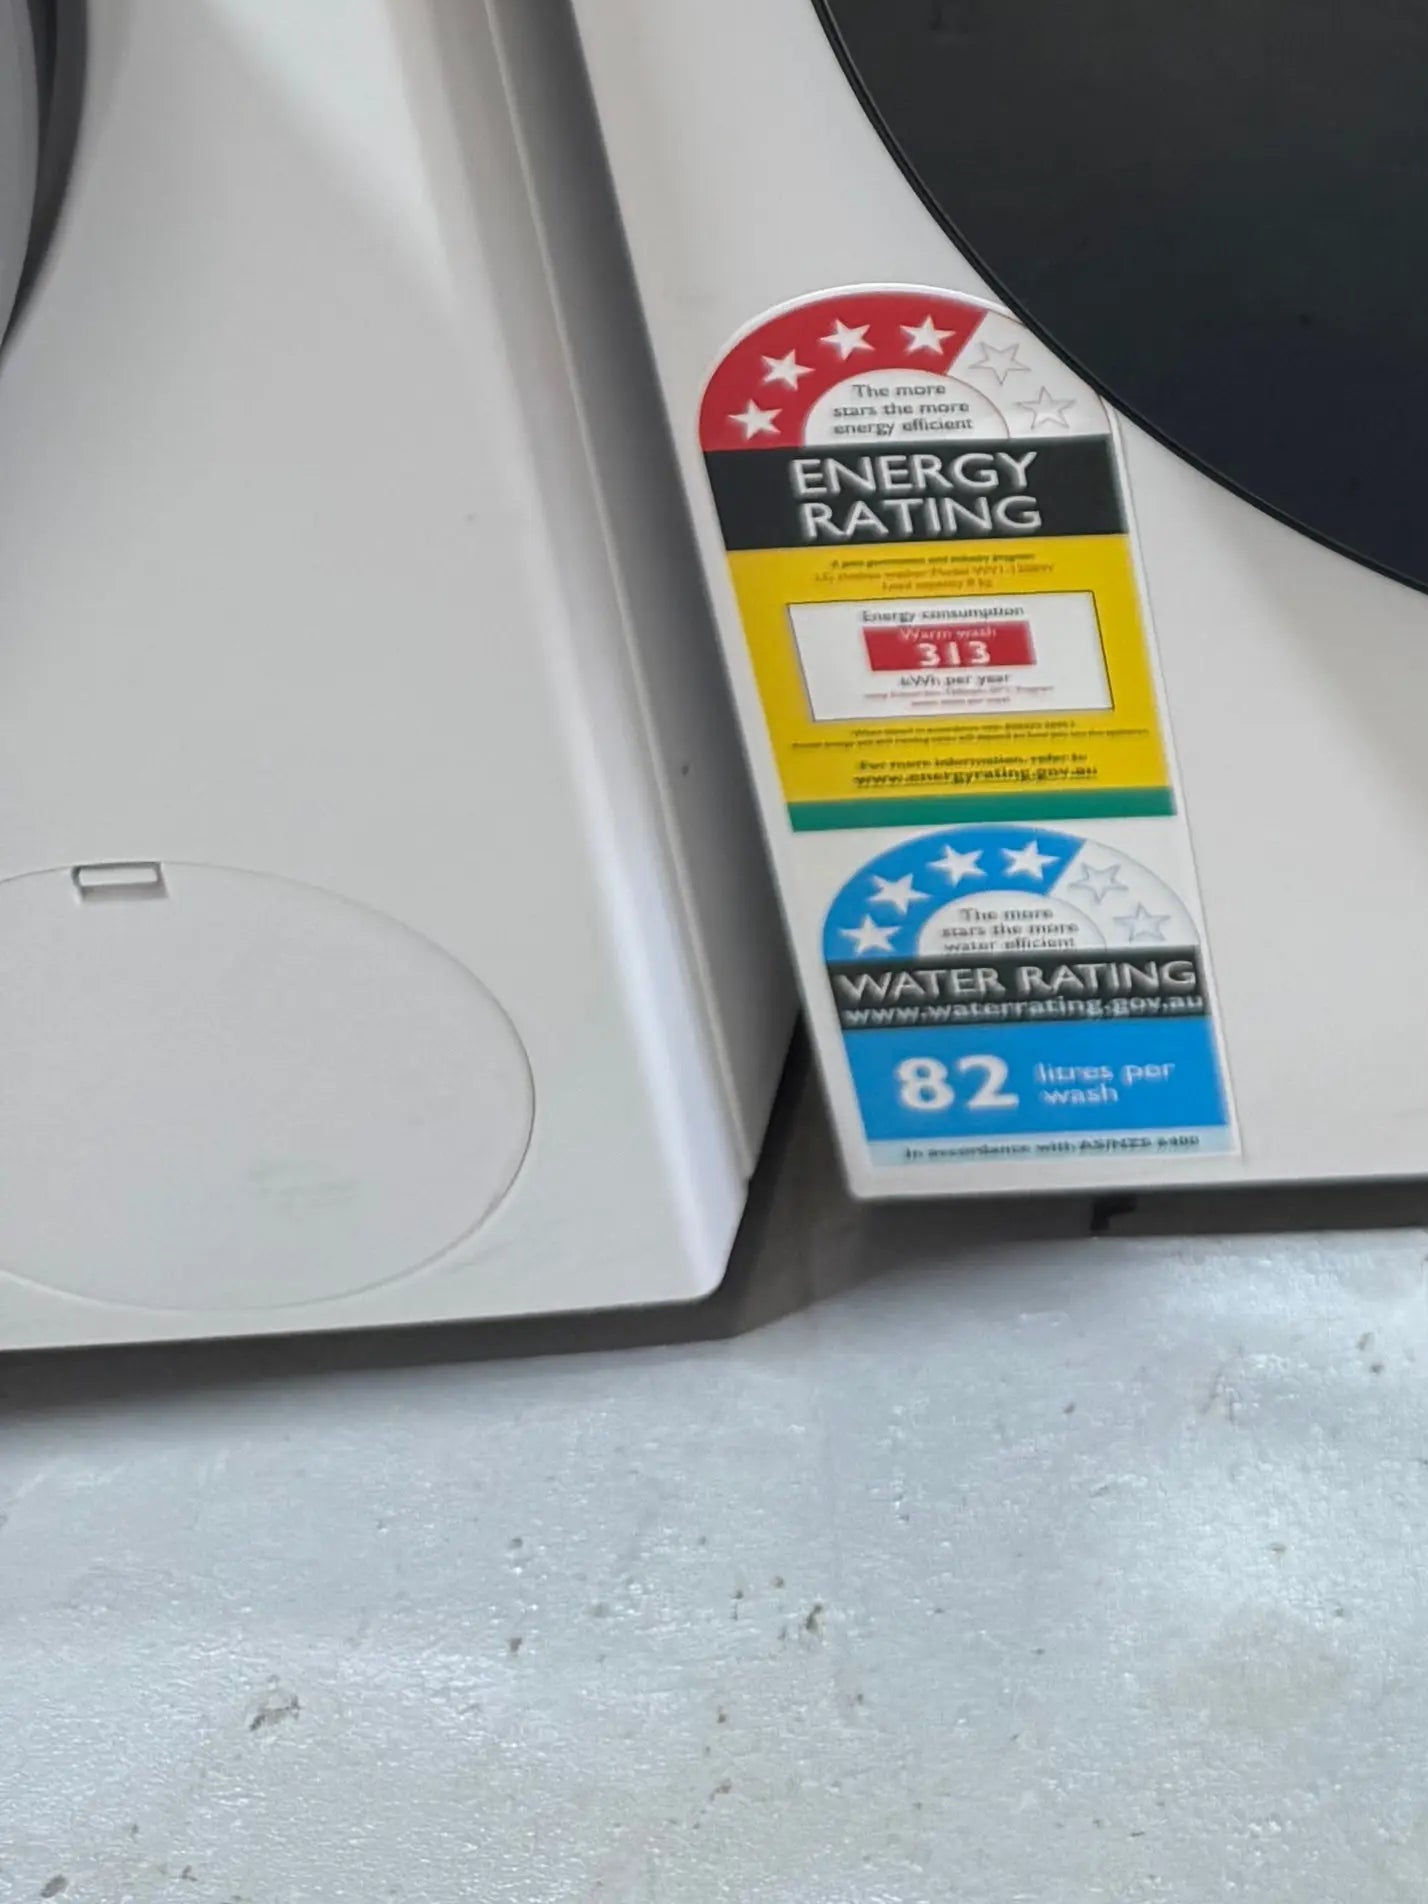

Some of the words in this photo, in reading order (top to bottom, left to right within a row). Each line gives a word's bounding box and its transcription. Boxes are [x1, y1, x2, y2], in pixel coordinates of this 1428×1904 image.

[853, 384, 888, 397] The
[896, 384, 945, 396] more
[833, 404, 876, 417] stars
[883, 402, 914, 415] the
[920, 402, 969, 414] more
[833, 421, 894, 436] energy
[903, 418, 973, 431] efficient
[790, 451, 1036, 494] ENERGY
[803, 495, 1041, 539] RATING
[919, 641, 990, 667] 313
[840, 967, 1005, 1005] WATER
[1018, 959, 1196, 995] RATING
[846, 995, 1203, 1023] www.waterrating.gov.au
[896, 1055, 1019, 1111] 82
[1038, 1061, 1113, 1083] litres
[1125, 1062, 1175, 1086] per
[1044, 1085, 1118, 1104] wash
